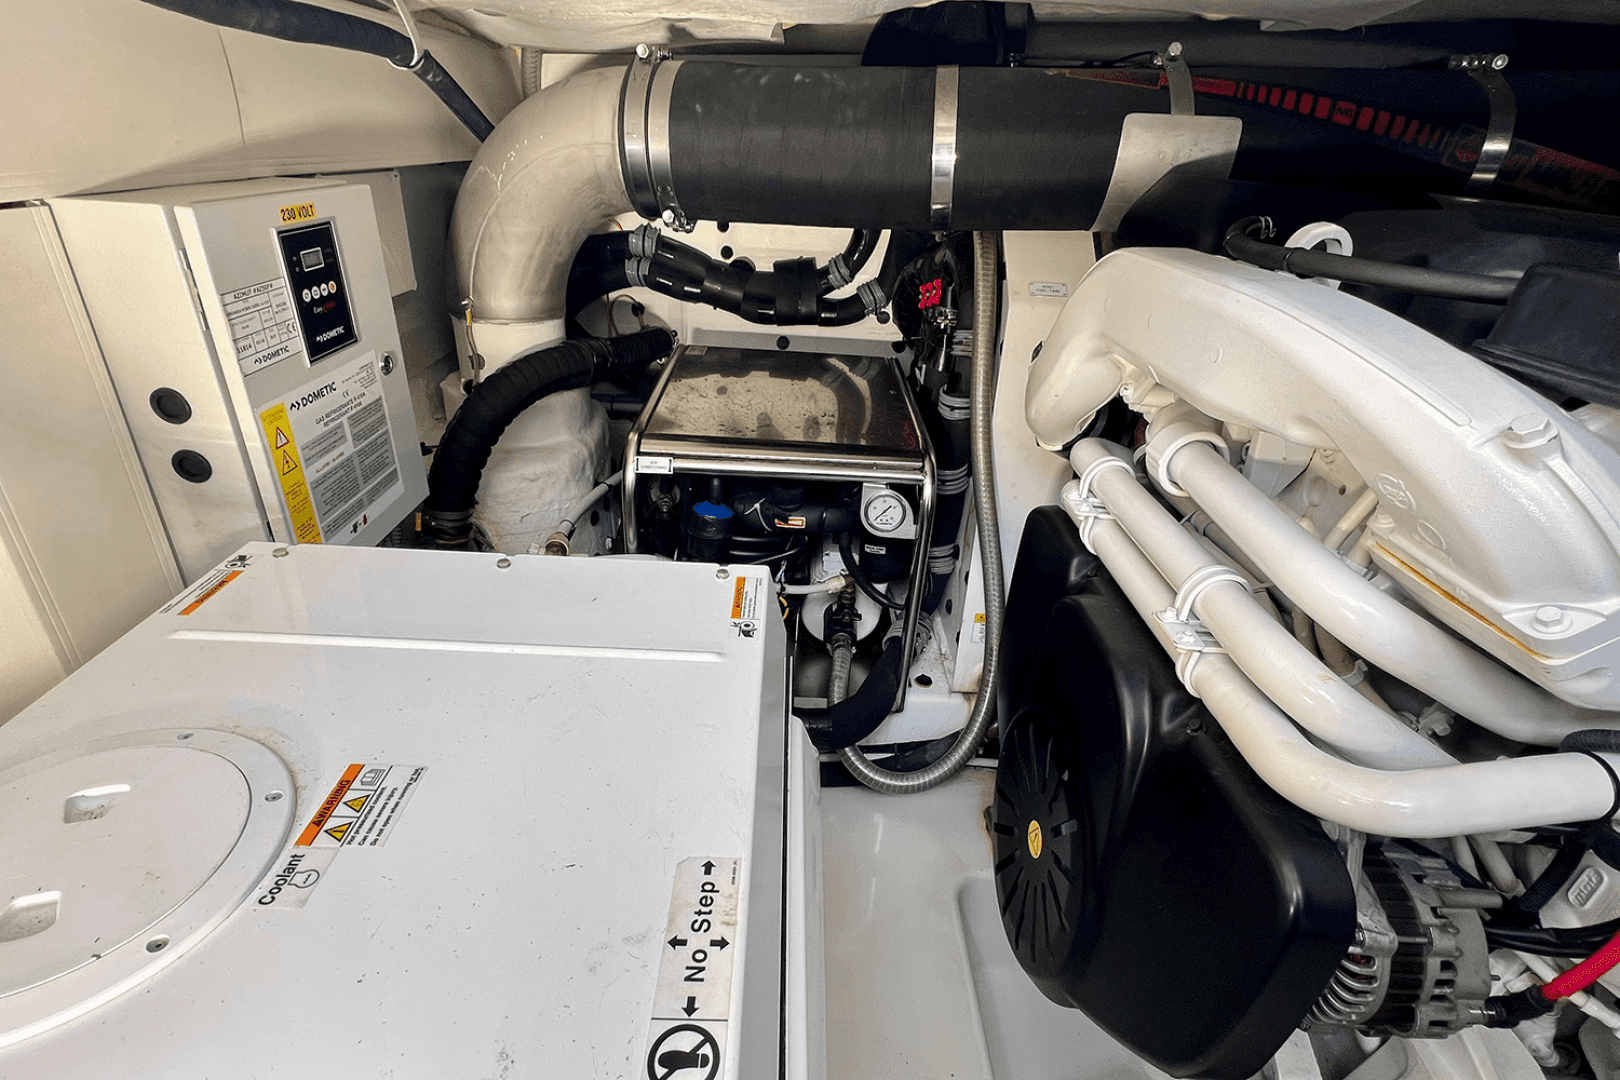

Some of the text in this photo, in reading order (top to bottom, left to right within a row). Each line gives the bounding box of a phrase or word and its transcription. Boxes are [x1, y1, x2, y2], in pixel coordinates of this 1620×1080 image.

[280, 204, 315, 222] 230 VOLT
[233, 289, 252, 300] AZIMUT
[323, 326, 345, 341] DOMETIC
[263, 345, 290, 363] DOMETIC
[301, 381, 337, 408] DOMETIC
[315, 415, 325, 425] GAS
[317, 779, 351, 821] WARNING
[346, 835, 357, 845] Hot
[358, 835, 368, 846] Can
[258, 854, 305, 906] Coolant
[683, 881, 720, 982] No Step
